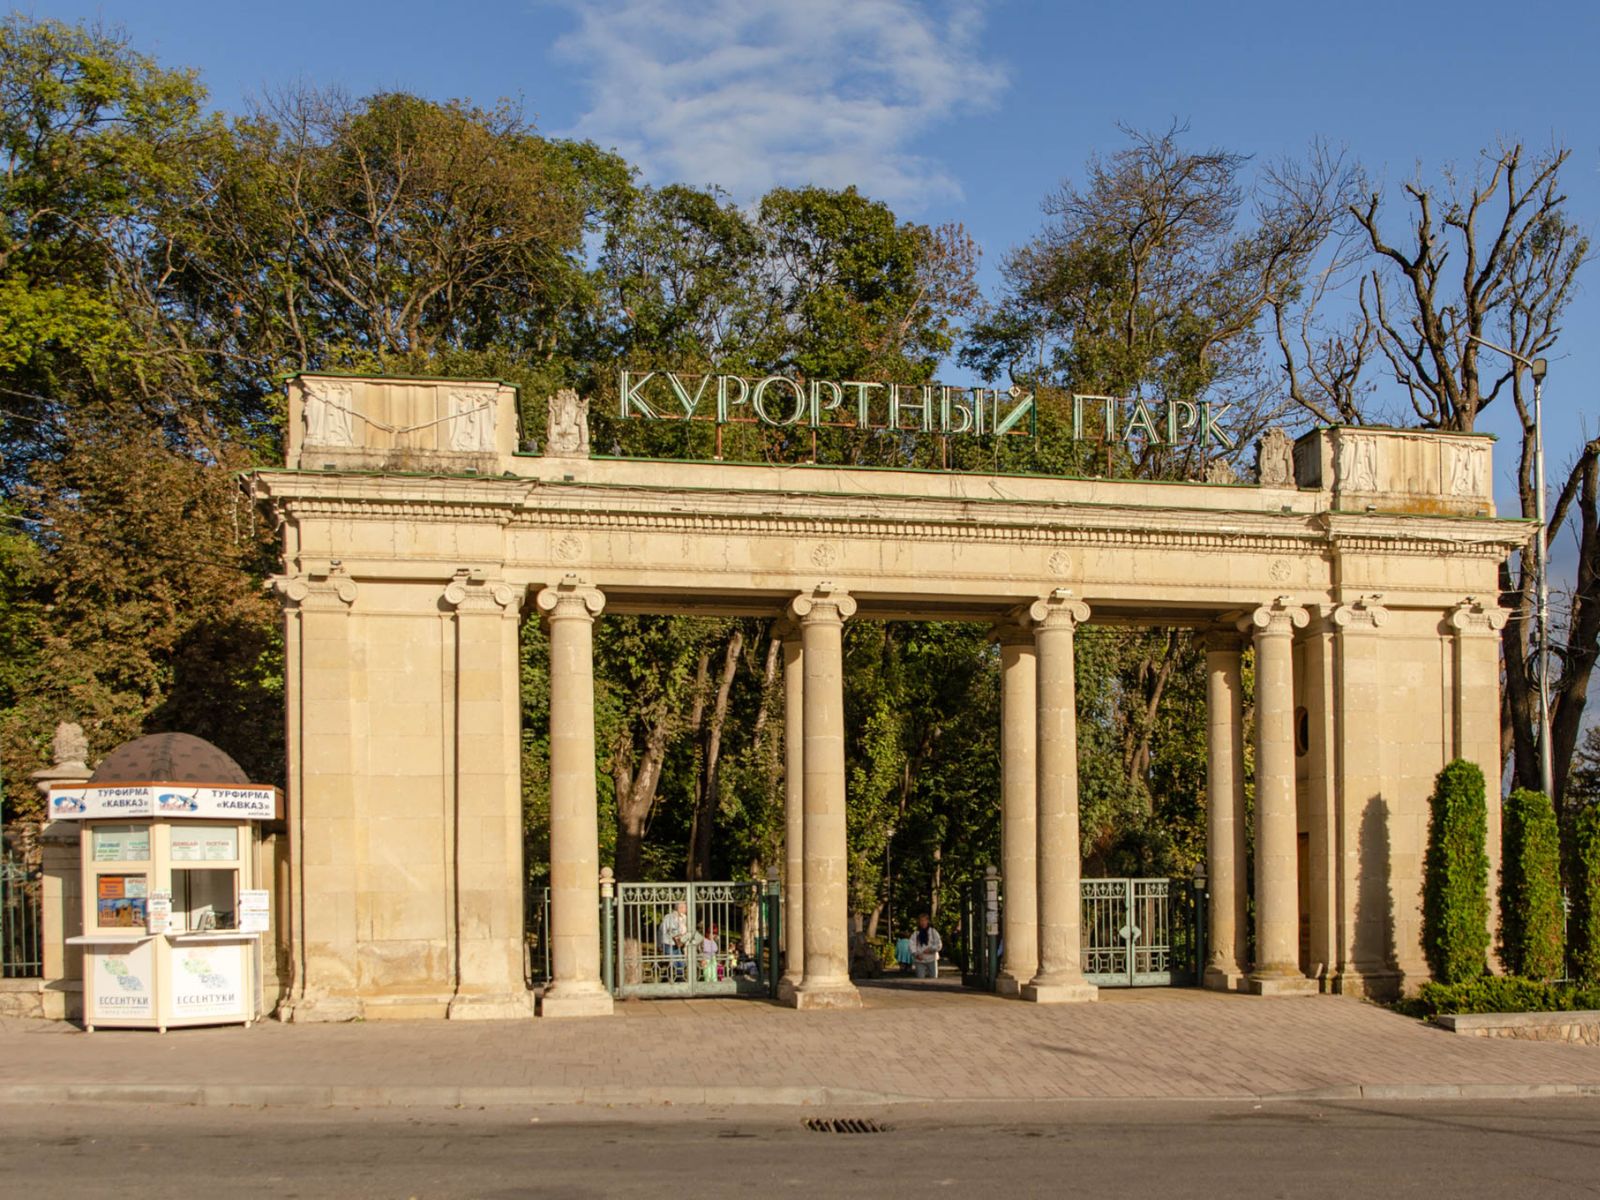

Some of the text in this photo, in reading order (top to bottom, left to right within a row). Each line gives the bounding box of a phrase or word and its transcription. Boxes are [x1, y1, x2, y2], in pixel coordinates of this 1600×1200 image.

[618, 370, 1234, 449] КУРОРТНЫЙ ПАРК
[98, 788, 149, 797] ТУРФИРМА
[212, 790, 271, 800] ТУРФИРМА
[102, 799, 149, 809] «КАВКАЗ»
[217, 801, 270, 811] «КАВКАЗ»
[99, 996, 149, 1005] ЕССЕНТУКИ
[177, 993, 235, 1005] ЕССЕНТУКИ
